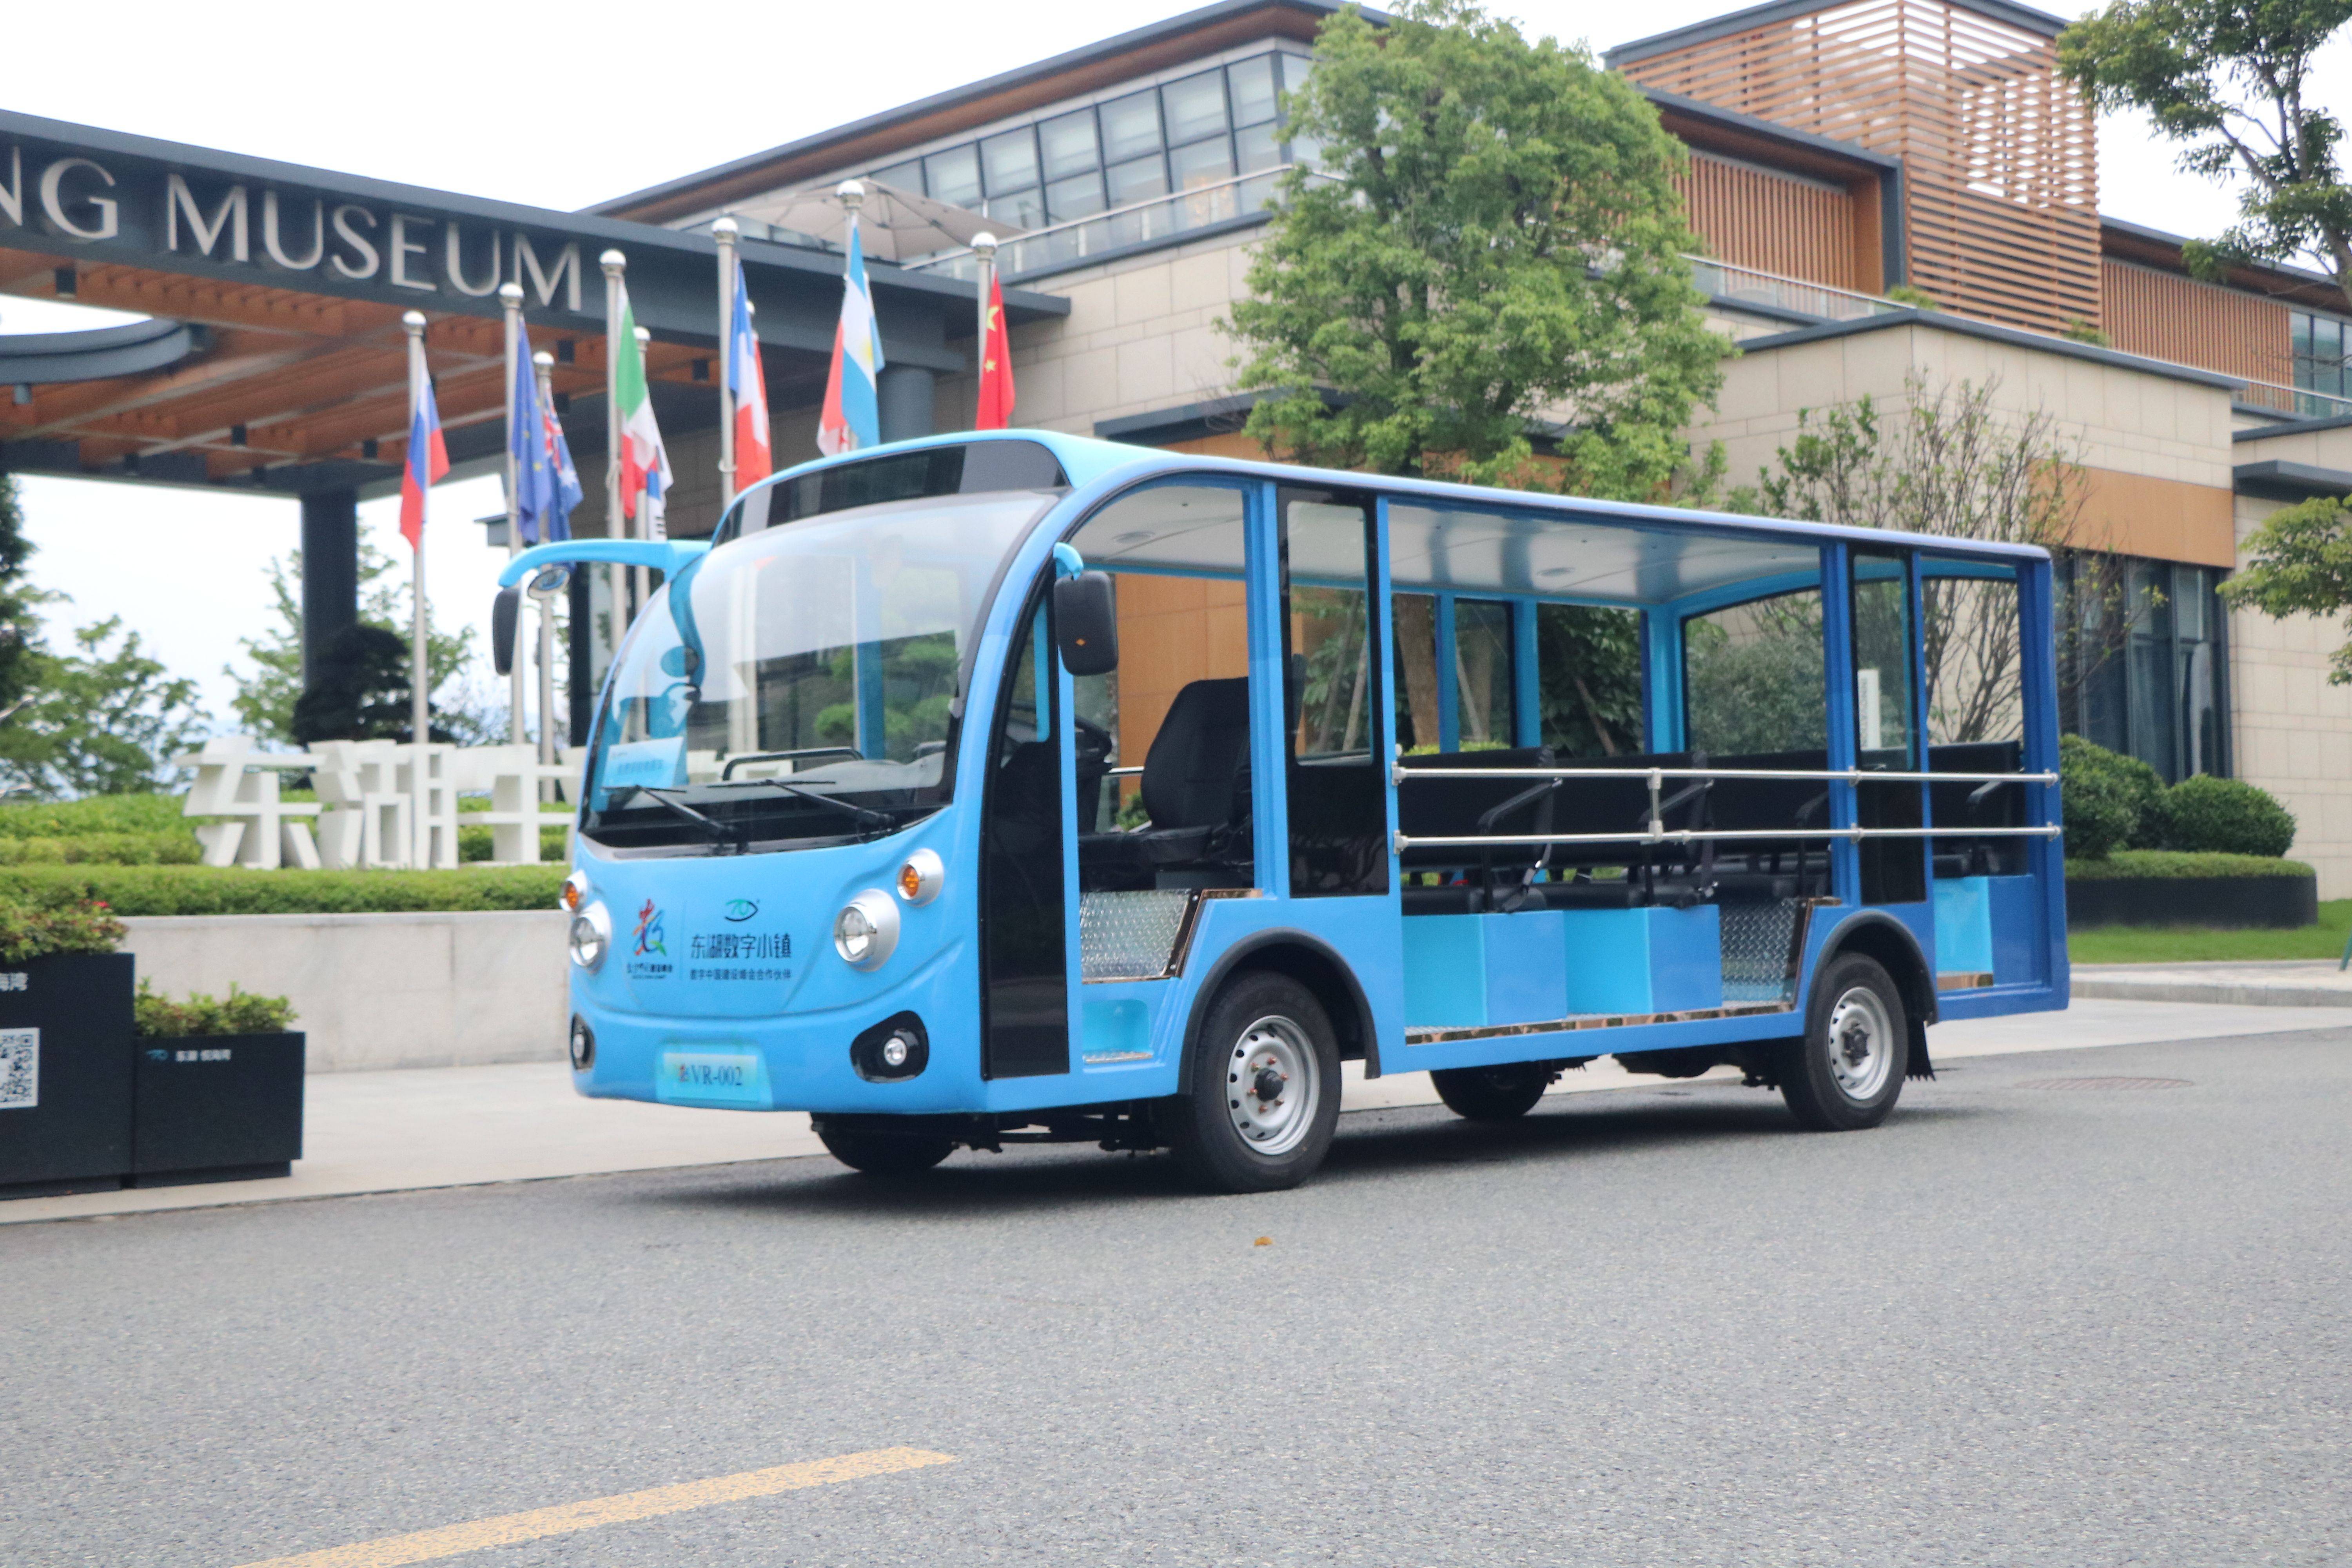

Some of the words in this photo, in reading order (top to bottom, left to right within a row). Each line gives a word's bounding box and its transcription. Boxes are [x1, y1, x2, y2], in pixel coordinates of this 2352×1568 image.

[167, 172, 582, 312] MUSEUM
[691, 933, 791, 959] 东湖数字小镇
[691, 1064, 743, 1086] VR-002
